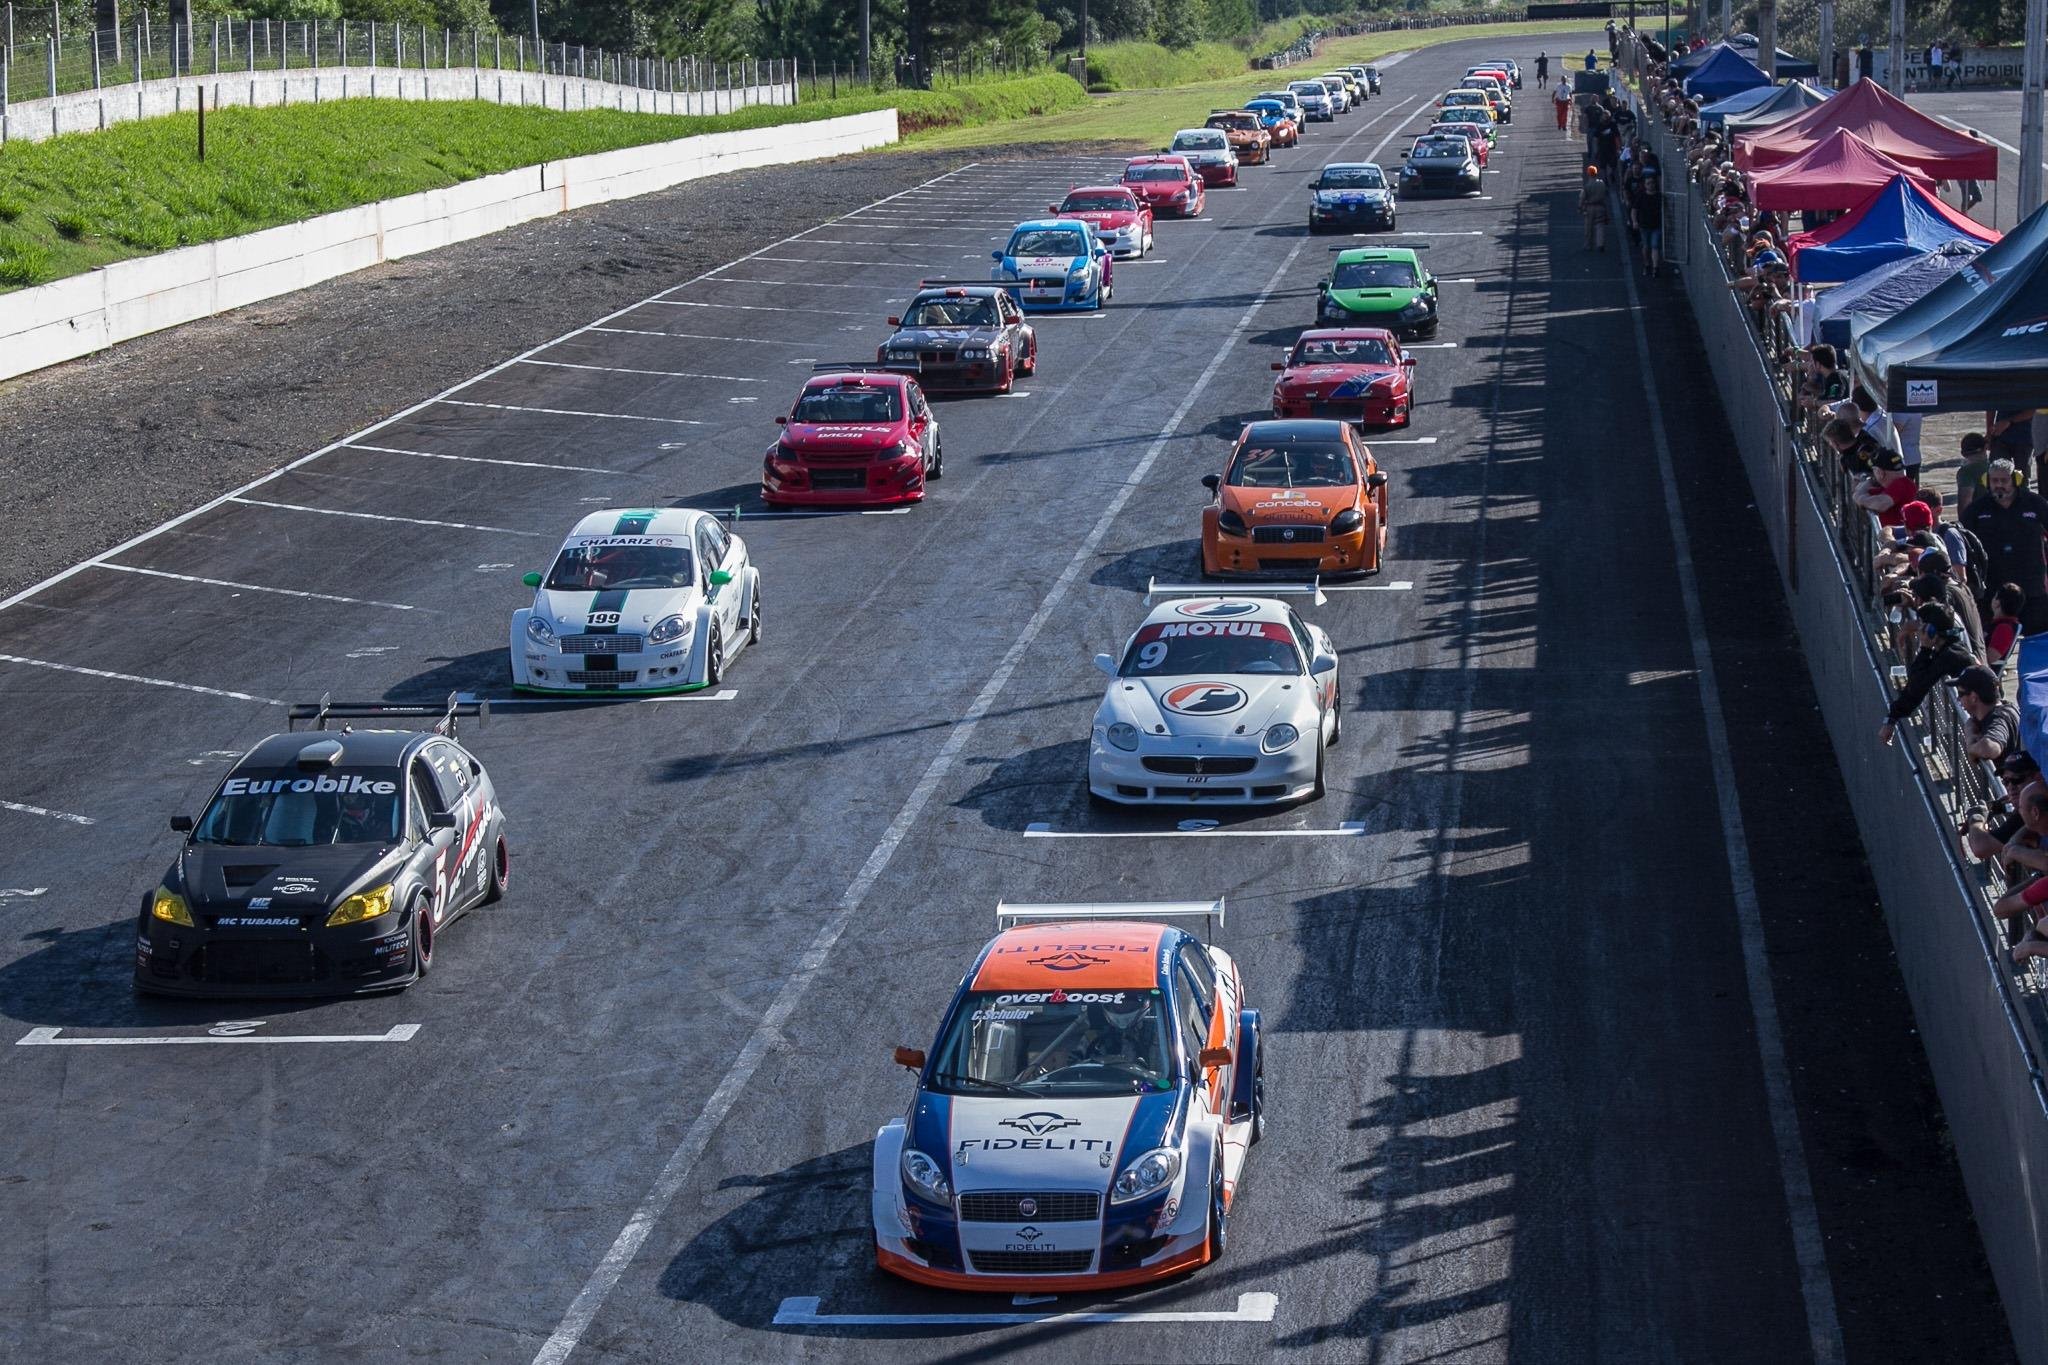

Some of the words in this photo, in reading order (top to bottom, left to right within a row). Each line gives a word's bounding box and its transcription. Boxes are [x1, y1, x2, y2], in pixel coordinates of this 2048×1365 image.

[2001, 321, 2048, 337] MC
[1256, 500, 1322, 508] conceito
[580, 538, 653, 546] CHAFARIZ
[587, 613, 621, 624] 199
[1160, 622, 1266, 638] MOTUL
[660, 648, 688, 659] CHAFARIZ
[1138, 642, 1168, 669] 9
[222, 775, 397, 796] Eurobike
[240, 916, 300, 925] TUBARÃO
[995, 988, 1126, 1005] overboost
[958, 1137, 1112, 1152] FIDELITI
[1005, 1243, 1056, 1251] FIDELITI
